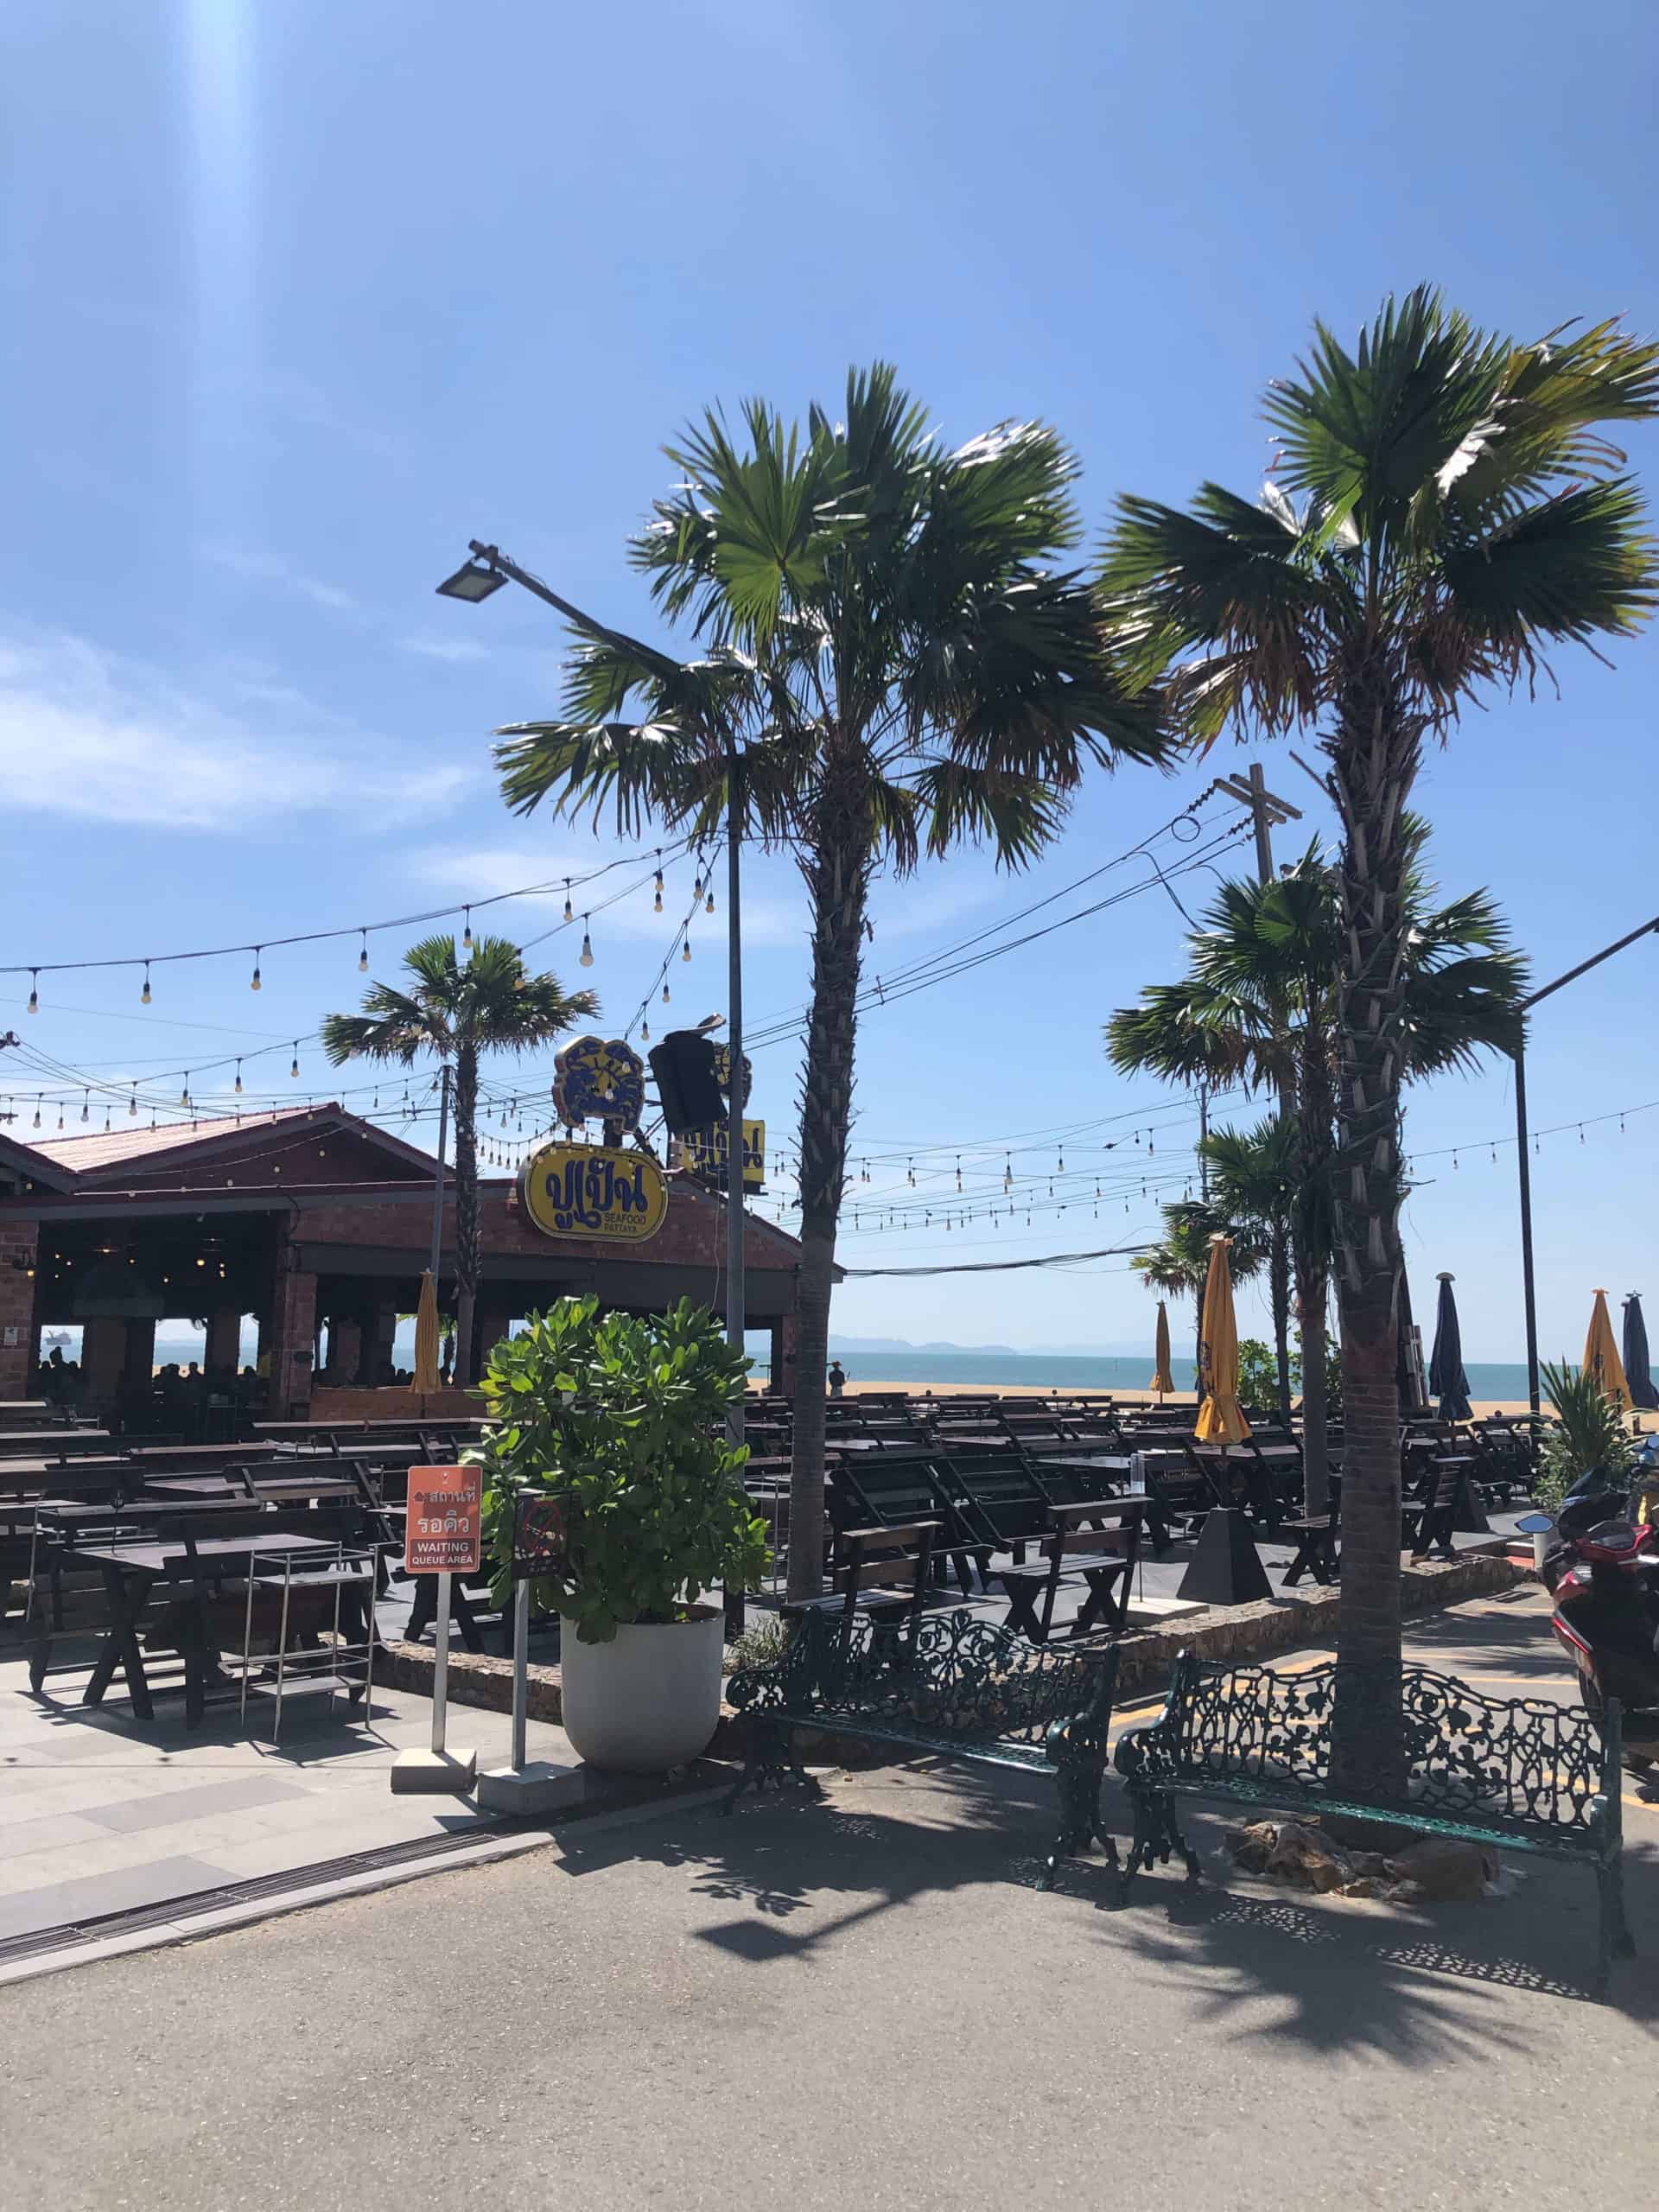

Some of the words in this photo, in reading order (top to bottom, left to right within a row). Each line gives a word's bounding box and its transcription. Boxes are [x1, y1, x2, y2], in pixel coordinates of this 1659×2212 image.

[546, 1156, 648, 1229] ปูเป็น
[605, 1212, 646, 1224] SEAFOOD
[605, 1223, 637, 1231] PATTAYA
[429, 1482, 475, 1503] สถานที่
[417, 1510, 470, 1534] รอคิว
[416, 1541, 469, 1553] WAITING
[411, 1556, 445, 1565] QUEUE
[448, 1555, 474, 1564] AREA
